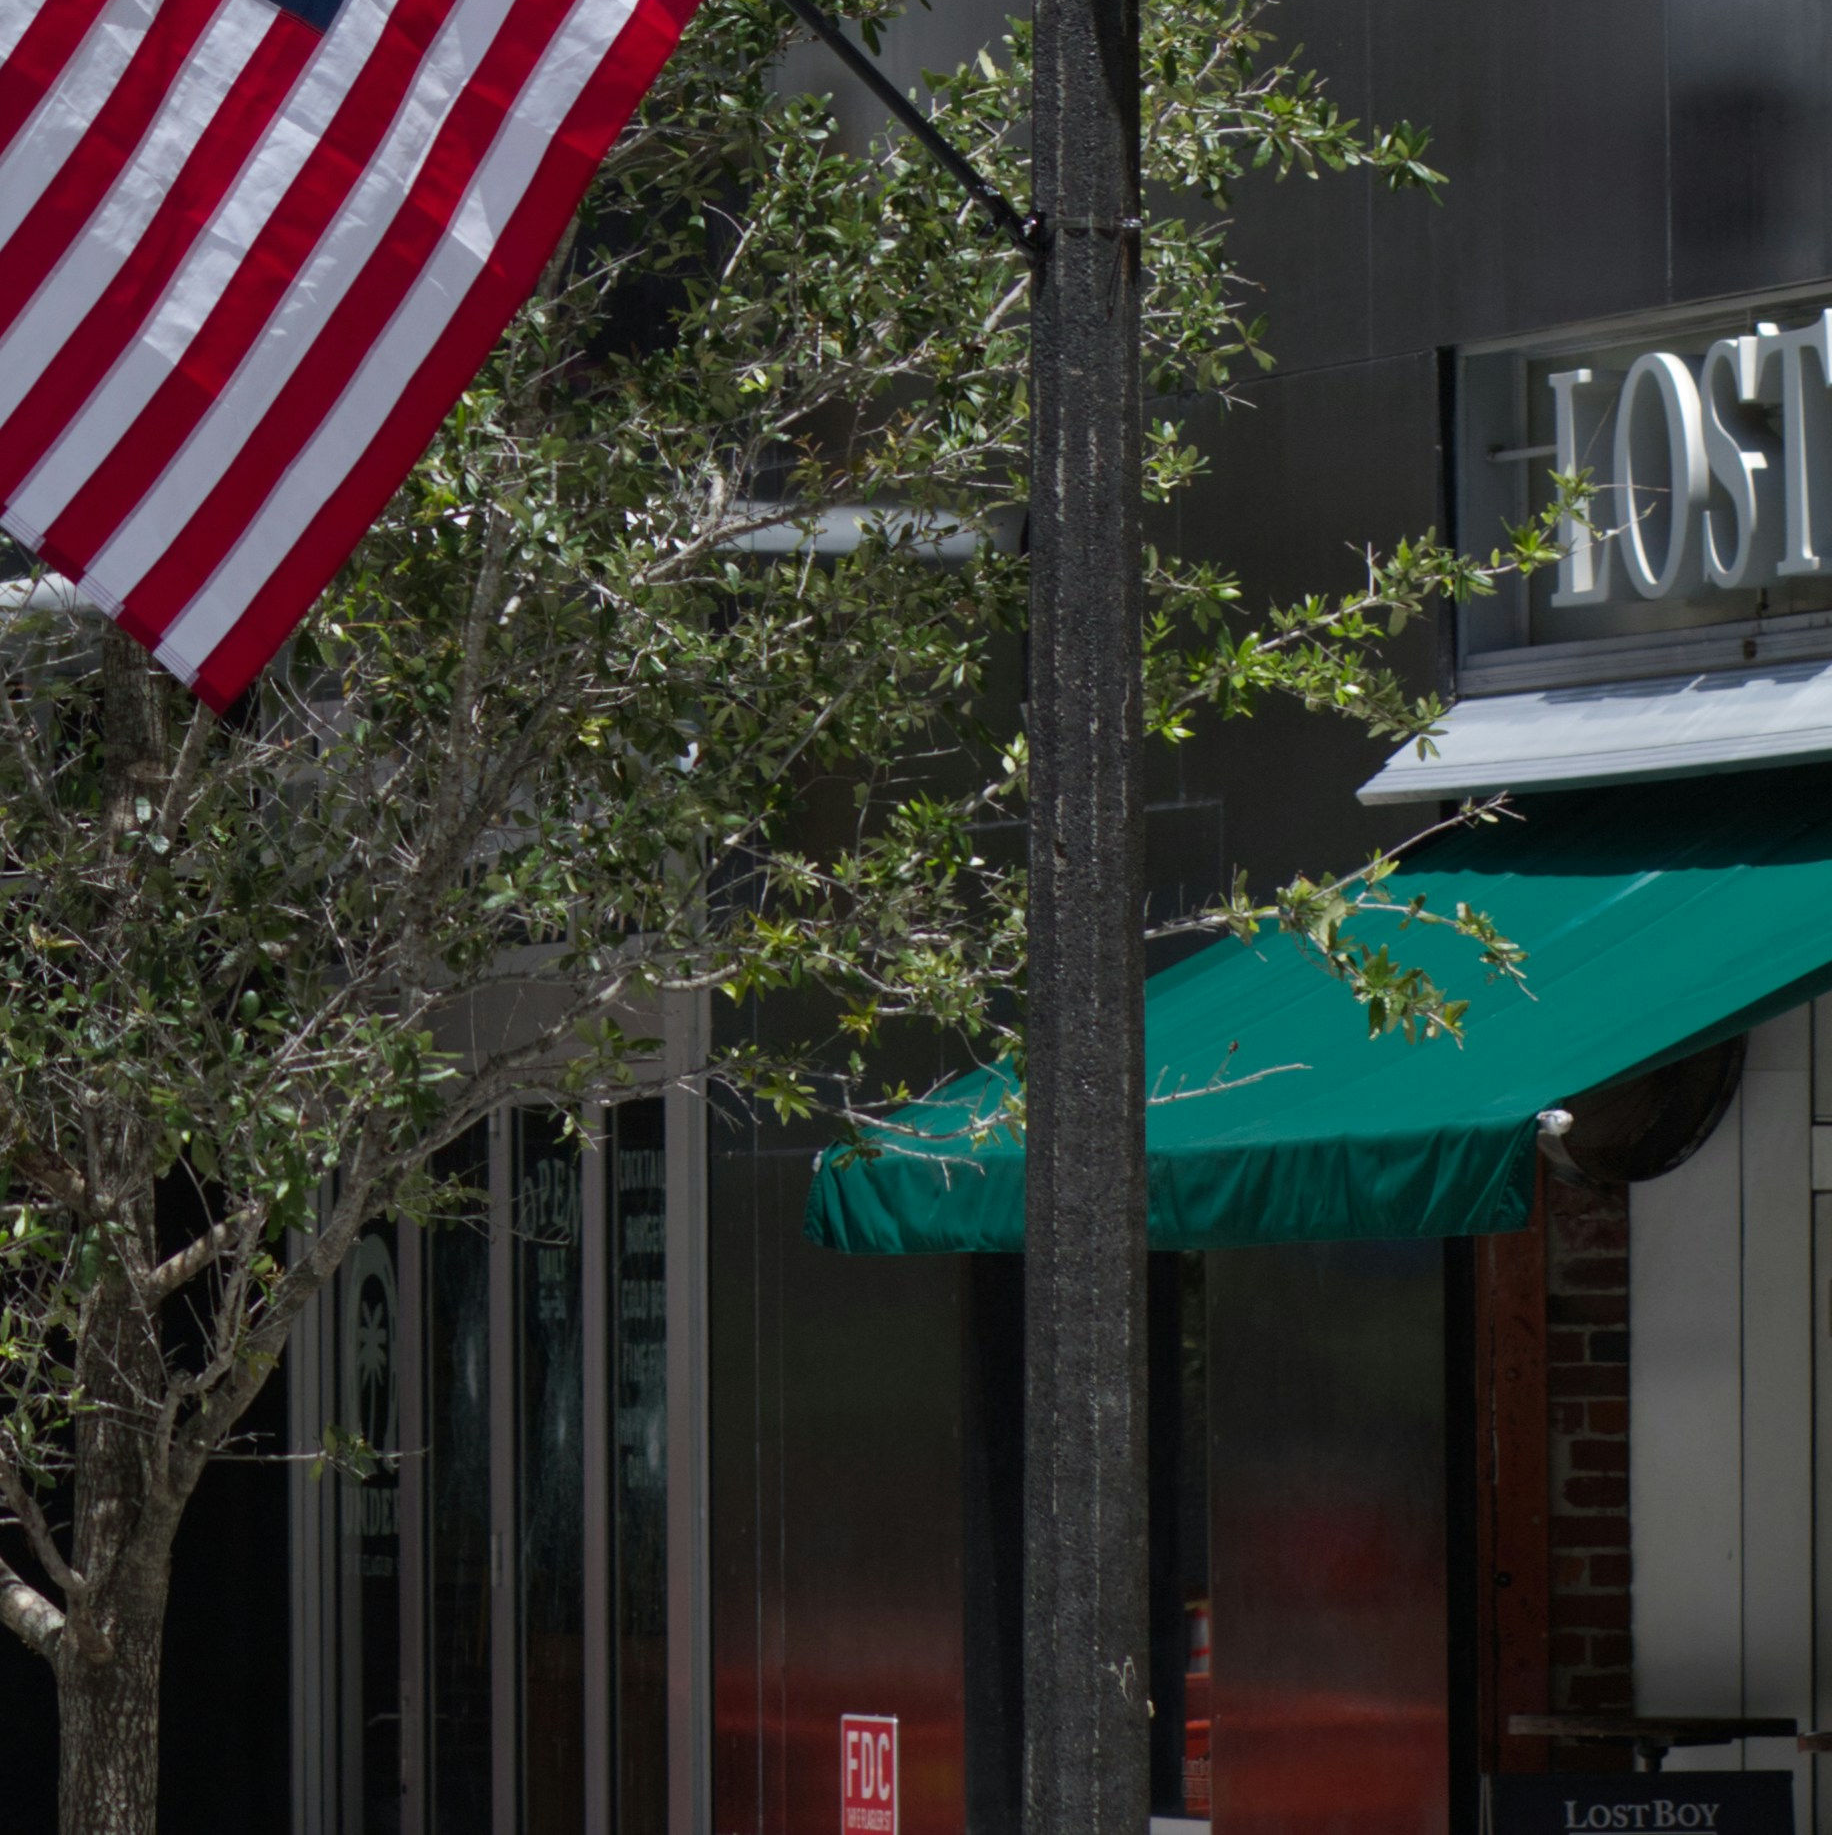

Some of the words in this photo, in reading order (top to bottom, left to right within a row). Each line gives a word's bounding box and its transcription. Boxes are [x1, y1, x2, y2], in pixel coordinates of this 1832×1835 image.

[1548, 307, 1832, 608] LOST
[520, 1157, 583, 1247] OPEN
[846, 1730, 891, 1801] FDC
